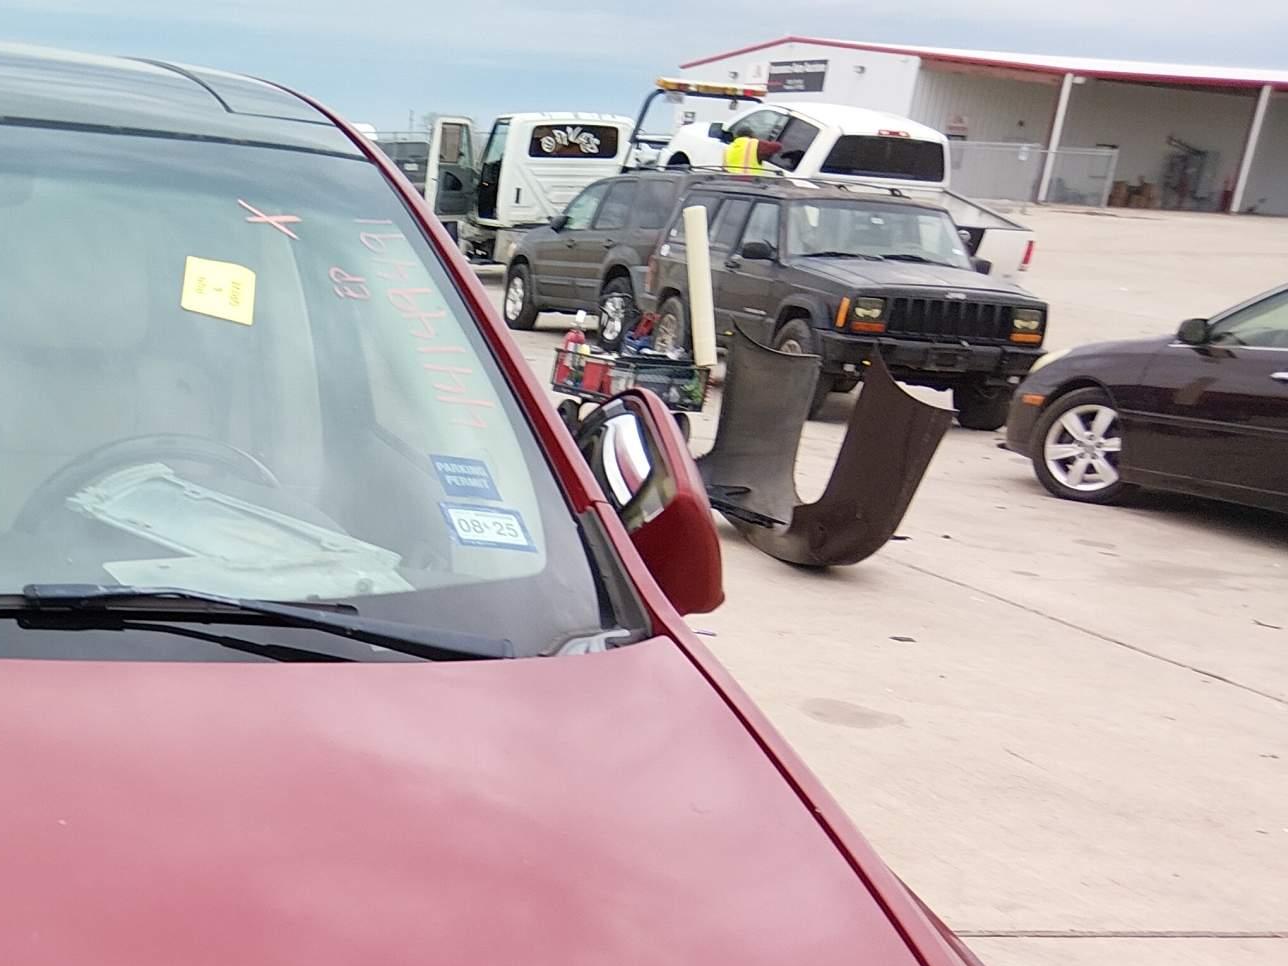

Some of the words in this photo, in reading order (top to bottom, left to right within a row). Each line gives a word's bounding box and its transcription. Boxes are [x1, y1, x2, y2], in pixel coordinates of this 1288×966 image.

[354, 218, 494, 429] 44149491
[444, 475, 491, 489] PERMIT
[457, 518, 485, 535] 08
[492, 521, 520, 538] 25
